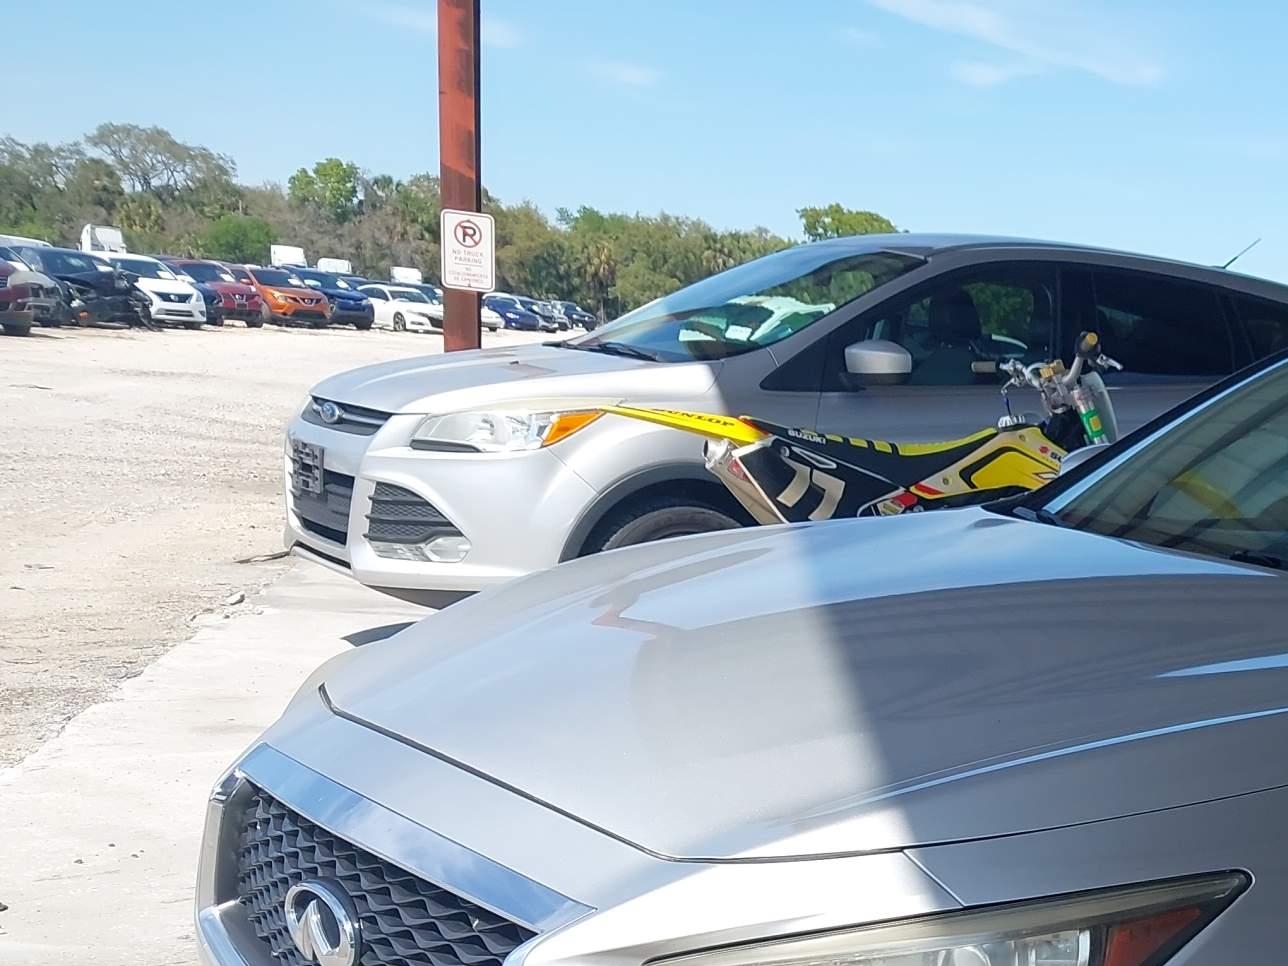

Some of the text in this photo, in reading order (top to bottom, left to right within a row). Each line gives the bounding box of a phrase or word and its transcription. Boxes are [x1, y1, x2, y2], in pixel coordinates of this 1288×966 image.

[452, 248, 484, 258] NO TRUCK
[454, 255, 482, 265] PARKING
